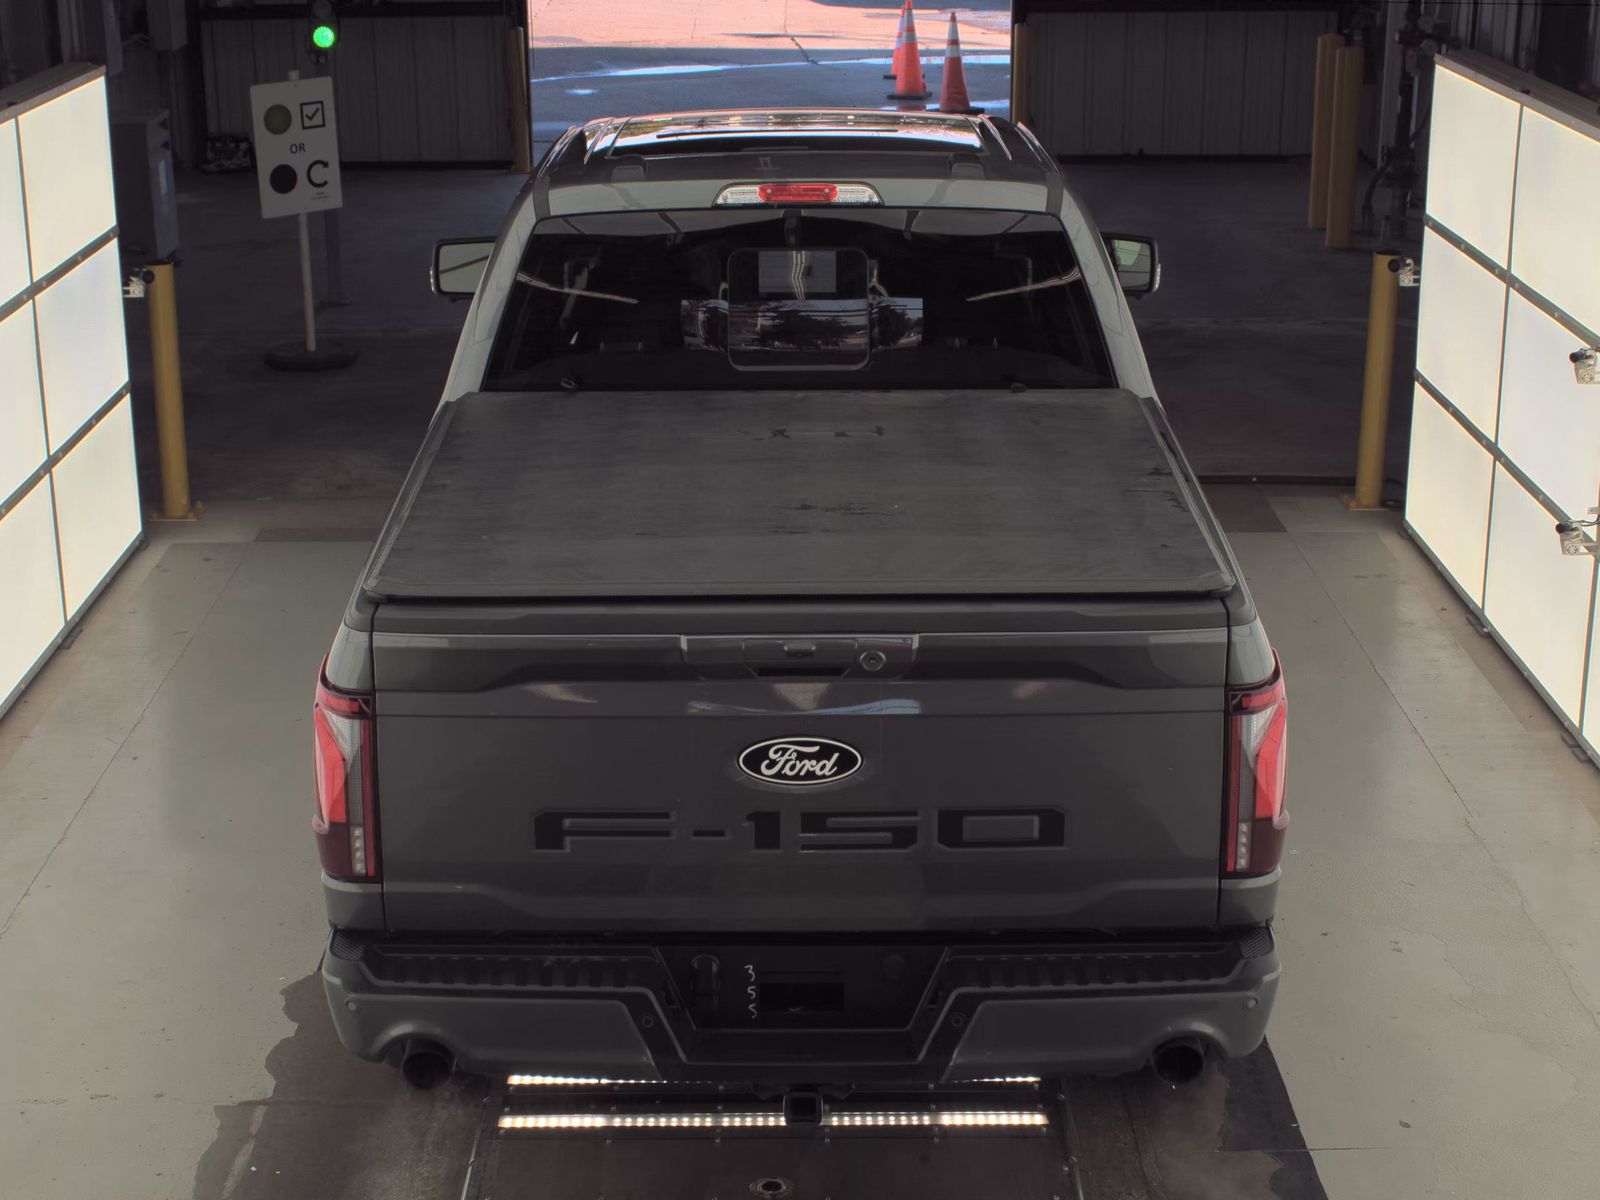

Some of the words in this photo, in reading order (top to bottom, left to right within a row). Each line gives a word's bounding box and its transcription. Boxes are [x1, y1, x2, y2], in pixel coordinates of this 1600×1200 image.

[289, 143, 306, 154] OR
[760, 743, 839, 776] Ford
[534, 807, 1066, 853] F-150
